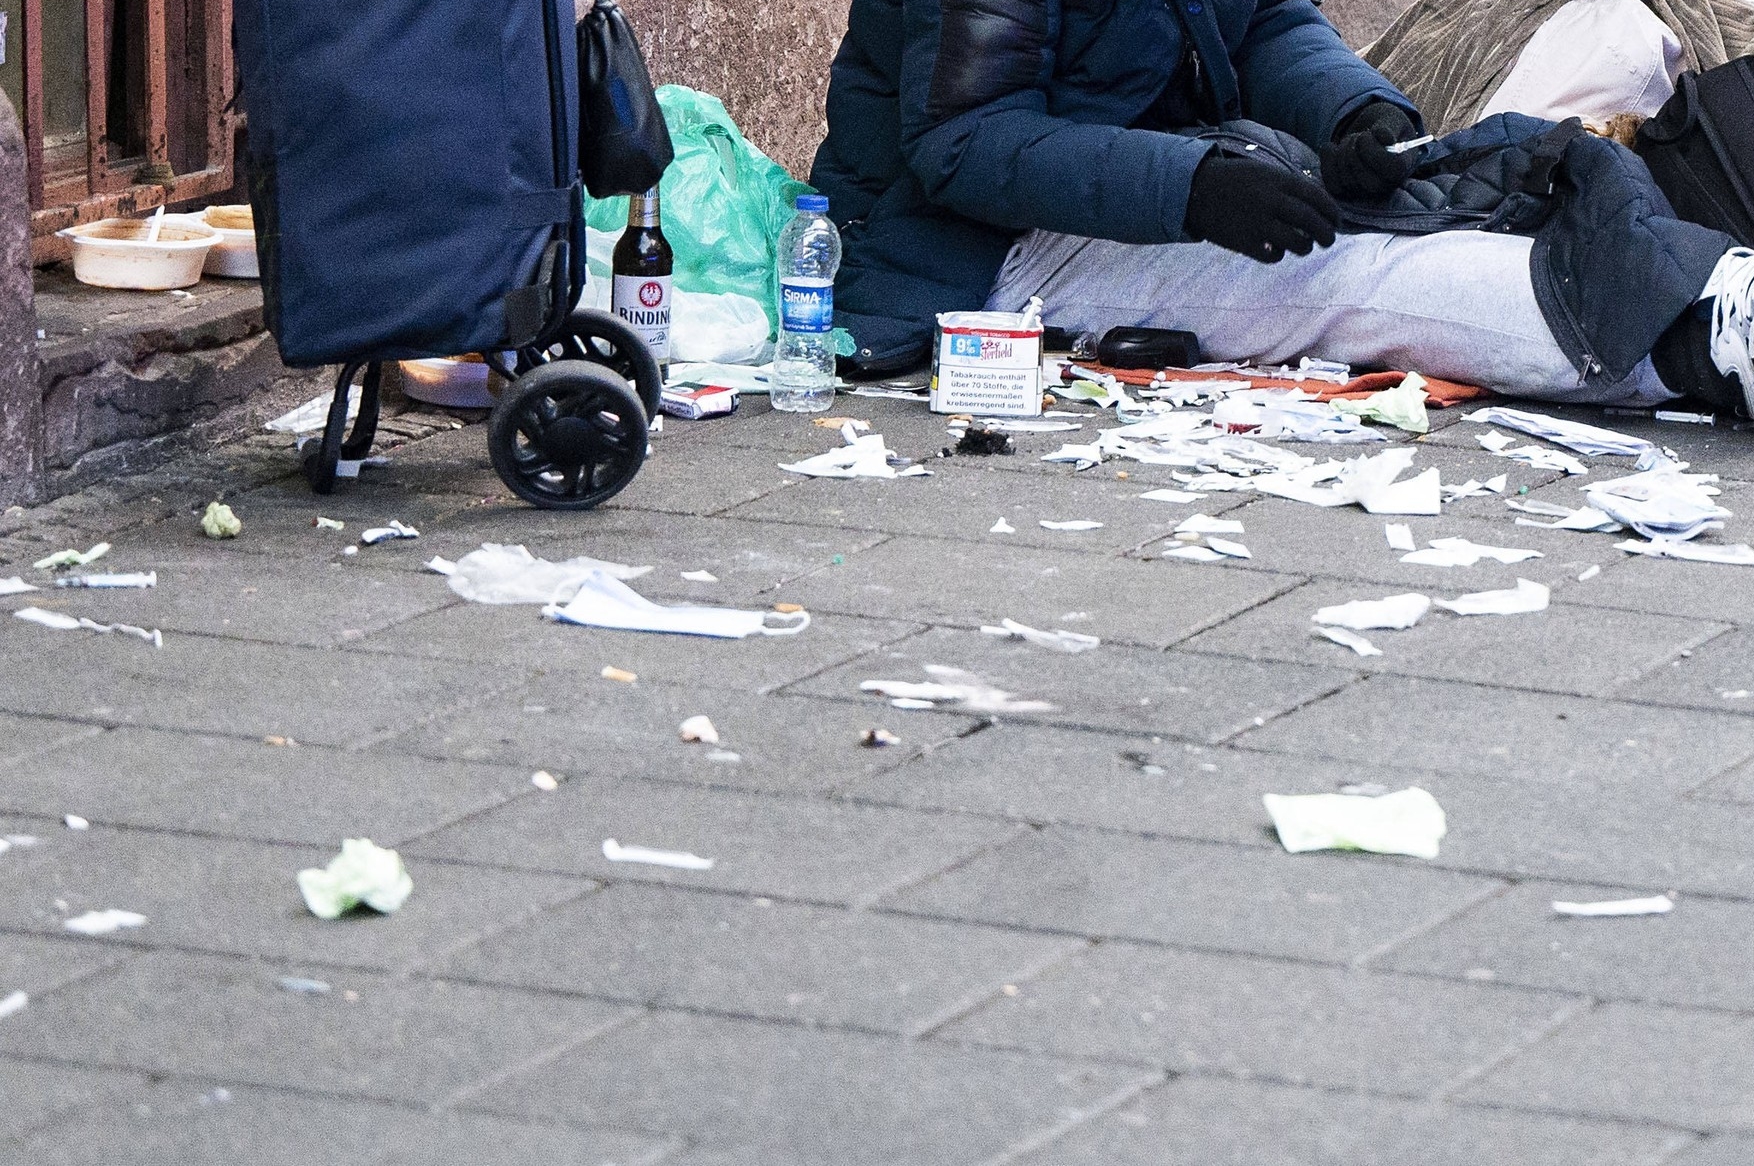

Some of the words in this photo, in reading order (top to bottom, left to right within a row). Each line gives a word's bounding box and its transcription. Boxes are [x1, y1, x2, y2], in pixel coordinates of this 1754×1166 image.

[784, 288, 820, 305] SIRMA
[950, 371, 997, 381] Tabakrauch
[998, 373, 1027, 382] enthält
[951, 381, 970, 389] über
[972, 381, 982, 389] 70
[951, 391, 1023, 400] erwiesenermaßen
[946, 399, 1006, 410] krebserregend
